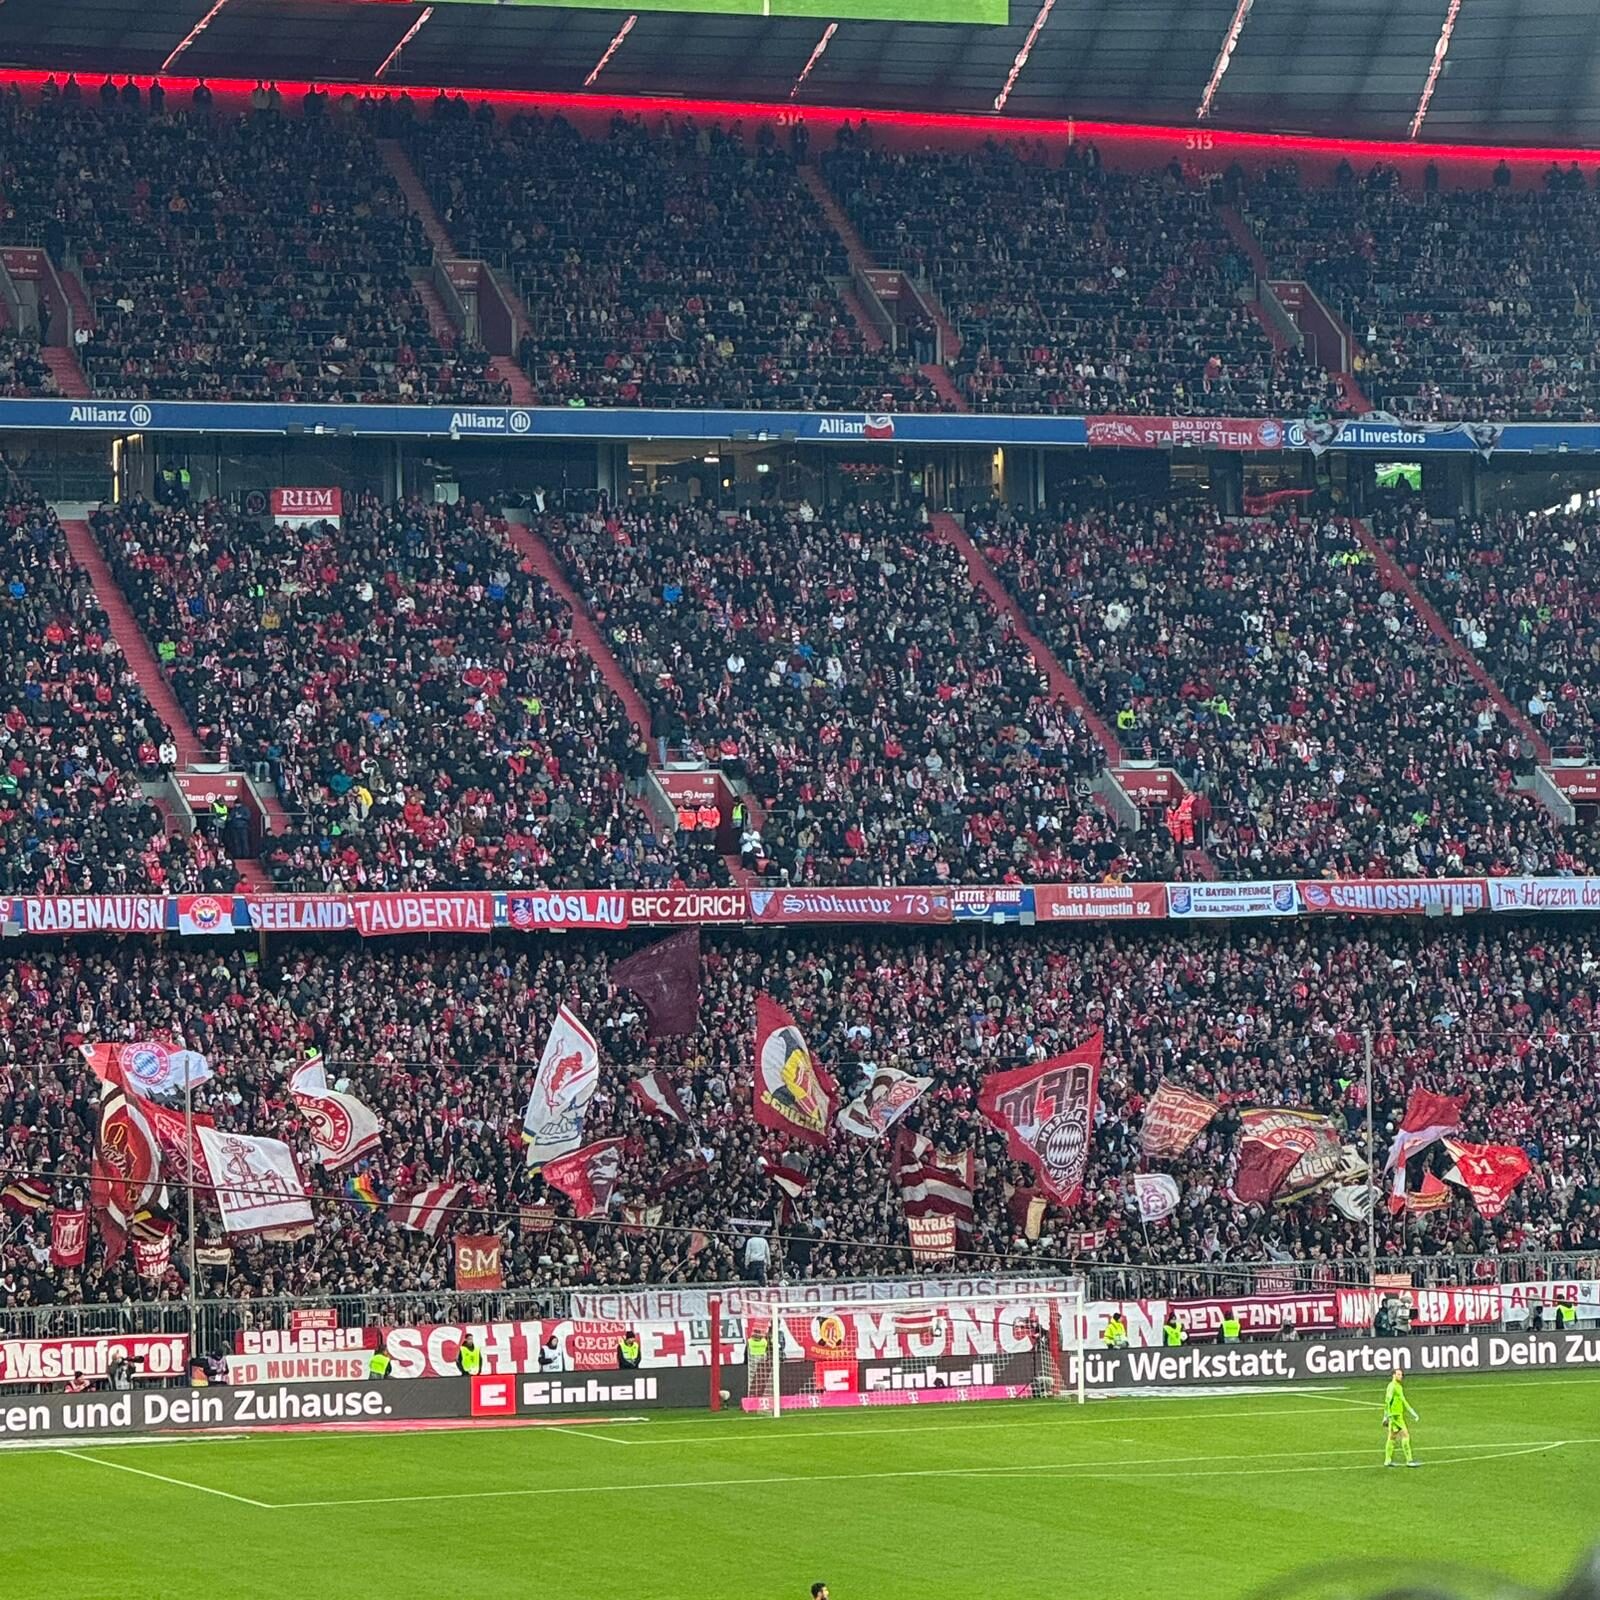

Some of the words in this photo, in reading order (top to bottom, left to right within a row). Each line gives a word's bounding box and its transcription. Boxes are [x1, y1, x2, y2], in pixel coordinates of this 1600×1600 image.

[70, 406, 126, 422] Allianz
[450, 412, 504, 428] Allianz
[1172, 421, 1194, 430] BAD
[1196, 421, 1223, 430] BOYS
[1360, 428, 1426, 443] Investors
[955, 889, 985, 903] LETZTE
[996, 889, 1021, 902] REIHE
[1068, 886, 1088, 899] FCB
[1090, 886, 1133, 899] Fanclub
[1193, 887, 1203, 896] FC
[1206, 887, 1236, 896] BAYERN
[1238, 886, 1271, 896] FREUNDE
[1330, 883, 1482, 908] SCHLOSSPANTHER
[1520, 882, 1578, 905] Herzen
[248, 903, 346, 929] SEELAND
[355, 899, 491, 931] TAUBERTAL
[532, 895, 625, 924] RÖSLAU
[632, 897, 671, 917] BFC
[673, 893, 746, 917] ZÜRICH
[782, 894, 892, 915] Südkurve
[1052, 903, 1084, 917] Sankt
[1085, 902, 1133, 918] Augustin
[908, 1216, 955, 1232] ULTRAS
[913, 1232, 953, 1246] MODUS
[1067, 1229, 1107, 1251] FCB
[459, 1247, 499, 1272] SM
[575, 1293, 648, 1321] VICINI
[659, 1292, 695, 1318] AL
[1418, 1291, 1449, 1322] RED
[1454, 1287, 1500, 1322] PRIDE
[136, 1340, 185, 1373] rot
[1128, 1348, 1296, 1382] Werkstatt,
[1306, 1344, 1411, 1374] Garten
[1421, 1337, 1479, 1369] und
[1490, 1335, 1556, 1366] Dein
[234, 1364, 257, 1384] ED
[866, 1364, 993, 1390] Einhell
[523, 1377, 657, 1405] Einhell
[64, 1395, 131, 1429] und
[144, 1392, 223, 1425] Dein
[234, 1387, 393, 1421] Zuhause.
